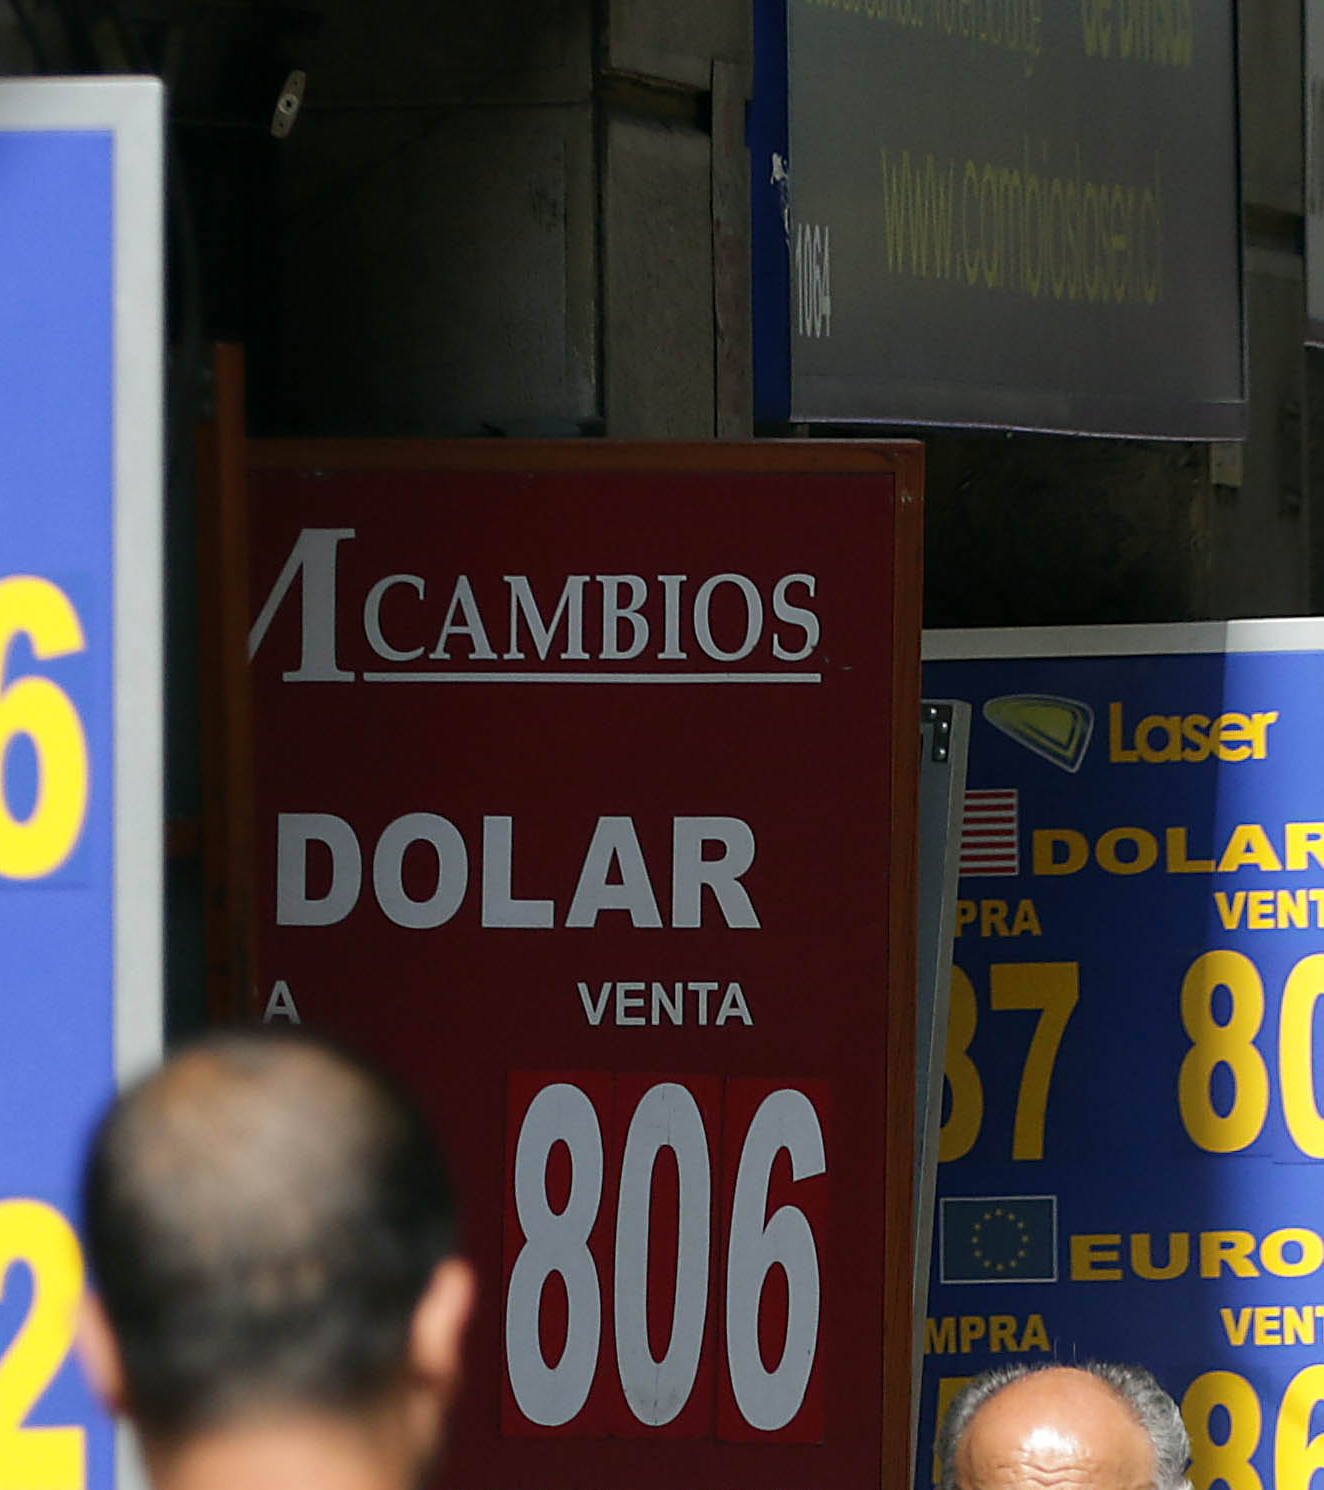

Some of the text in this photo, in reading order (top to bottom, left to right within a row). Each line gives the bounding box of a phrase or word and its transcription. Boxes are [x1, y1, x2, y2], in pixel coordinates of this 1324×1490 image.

[794, 222, 832, 340] 1064
[363, 572, 821, 662] CAMBIOS
[1109, 702, 1279, 763] Laser
[275, 811, 762, 929] DOLAR
[577, 981, 754, 1026] VENTA
[505, 1082, 826, 1432] 806
[1069, 1227, 1324, 1281] EURO
